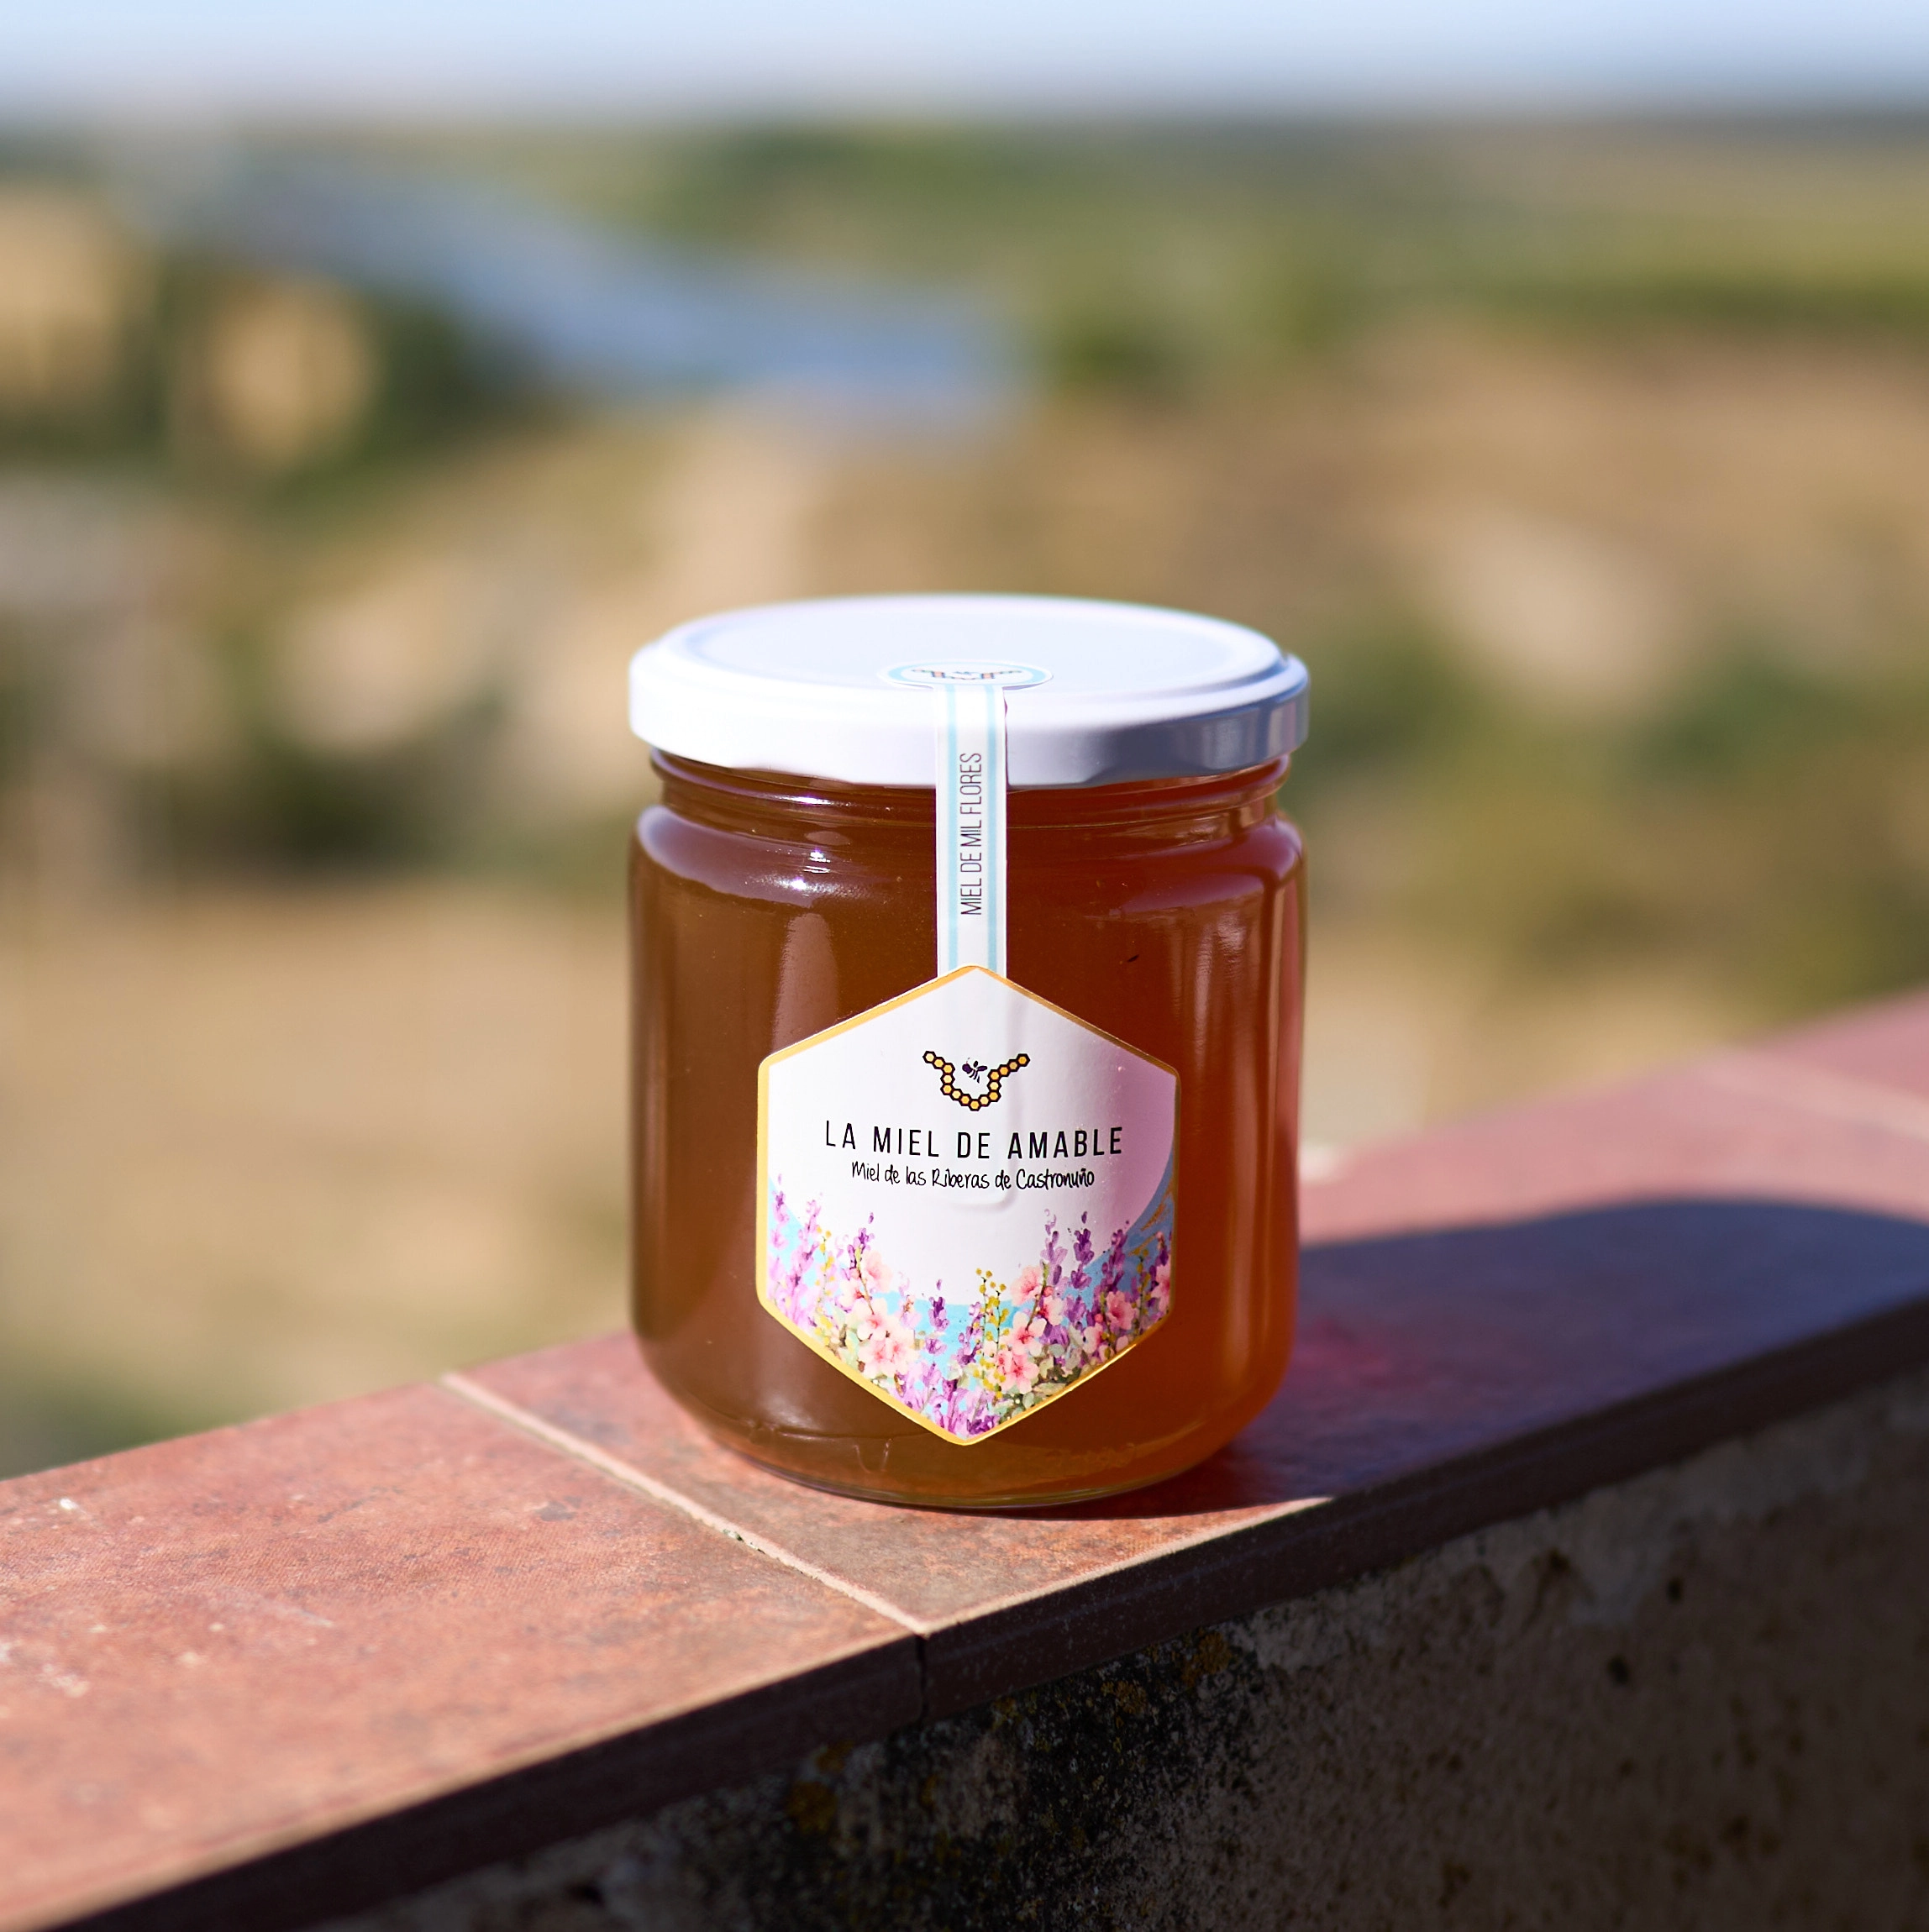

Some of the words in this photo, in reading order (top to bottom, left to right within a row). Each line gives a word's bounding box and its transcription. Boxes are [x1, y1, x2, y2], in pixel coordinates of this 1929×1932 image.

[959, 753, 982, 814] FLORES
[959, 820, 982, 847] MIL
[959, 852, 982, 873] DE
[960, 878, 982, 915] MIEL
[827, 1120, 856, 1150] LA
[873, 1126, 939, 1157] MIEL
[957, 1131, 991, 1159] DE
[1007, 1126, 1122, 1159] AMABLE
[851, 1161, 880, 1183] Miel
[885, 1164, 901, 1185] de
[906, 1165, 927, 1186] las
[932, 1168, 991, 1189] Riberas
[995, 1169, 1012, 1191] de
[1016, 1167, 1096, 1191] Castronuño
